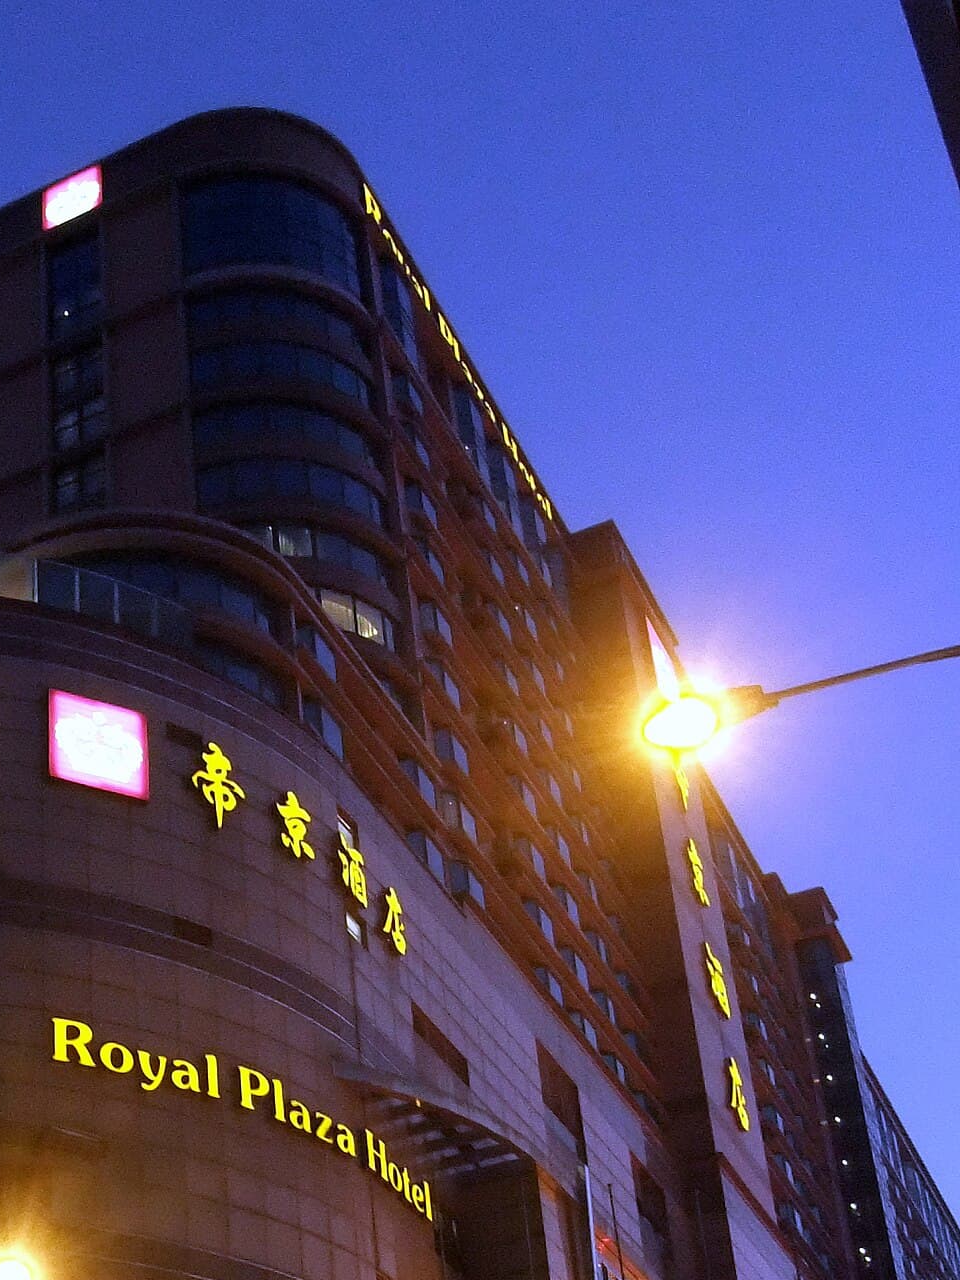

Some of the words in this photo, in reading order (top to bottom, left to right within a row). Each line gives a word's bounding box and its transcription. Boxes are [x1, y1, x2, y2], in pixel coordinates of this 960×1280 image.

[192, 741, 408, 956] 帝京酒店
[51, 1016, 221, 1099] Royal
[237, 1064, 357, 1157] Plaza
[365, 1128, 433, 1222] Hotel
